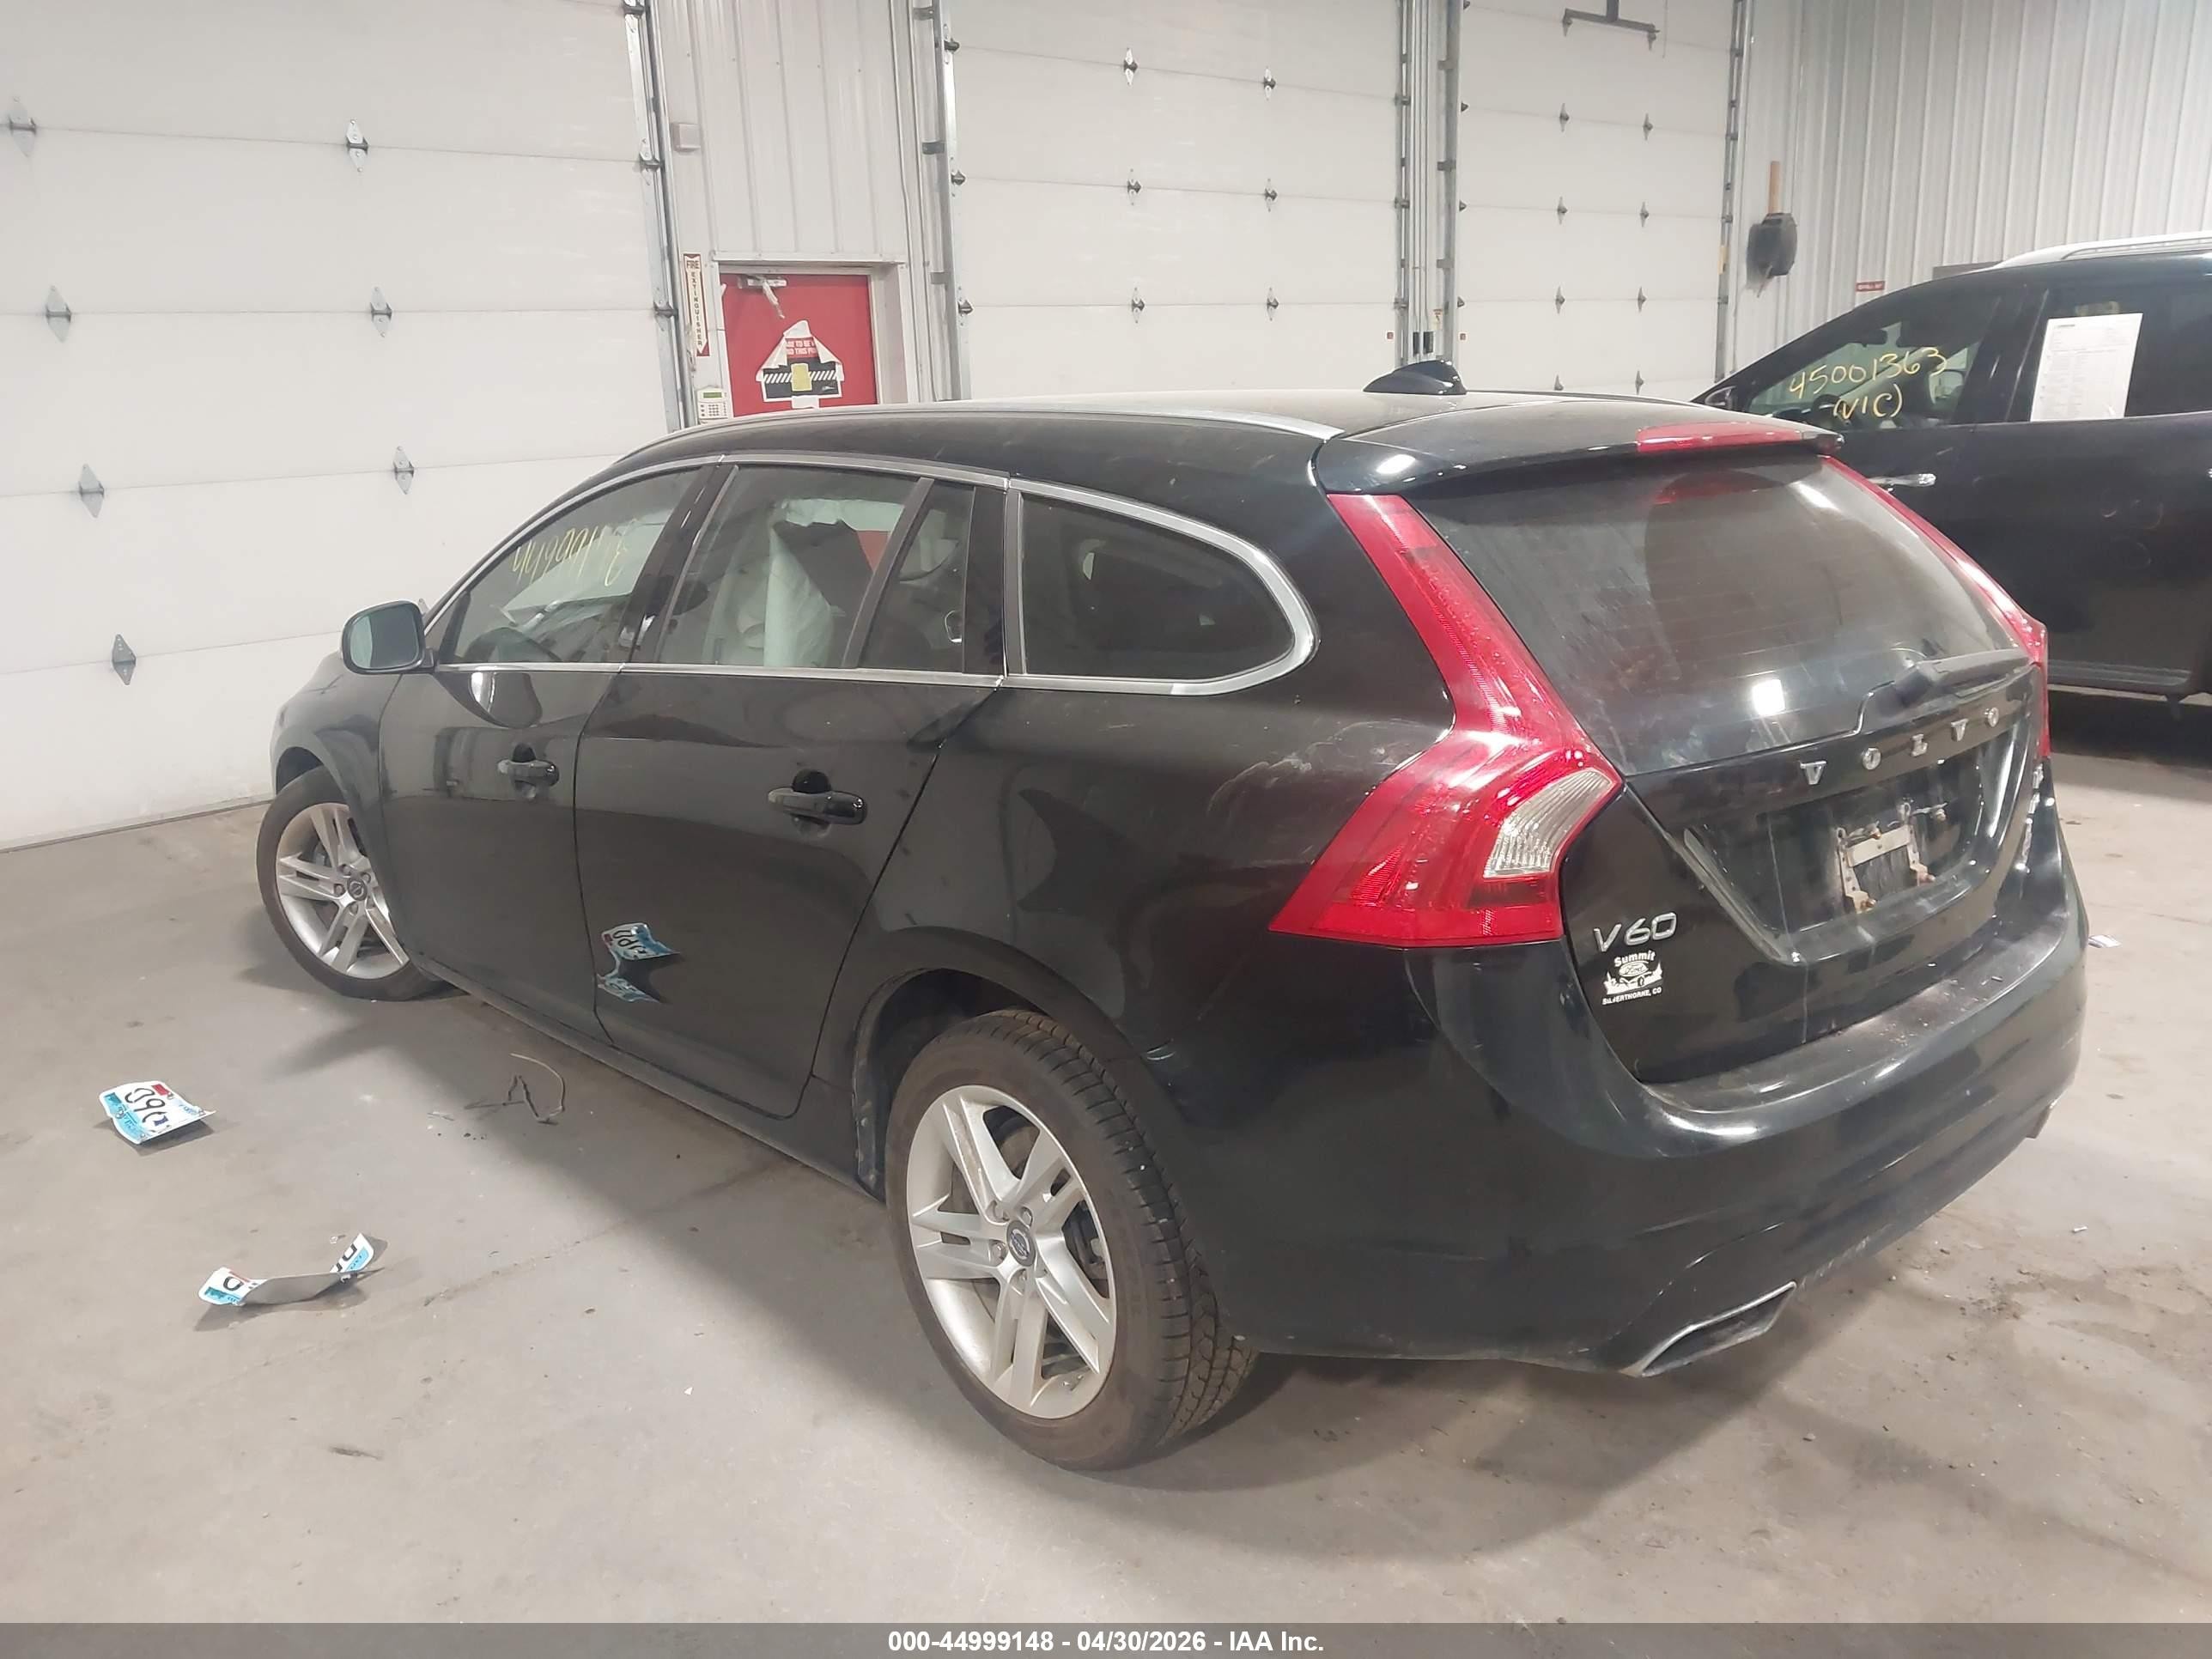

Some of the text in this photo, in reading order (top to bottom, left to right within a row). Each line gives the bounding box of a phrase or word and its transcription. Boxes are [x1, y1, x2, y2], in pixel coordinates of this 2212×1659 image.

[686, 259, 700, 269] FIRE
[1790, 346, 1948, 399] 45001363
[1800, 707, 2000, 786] VOLVO
[1594, 912, 1677, 952] V60
[1614, 950, 1656, 967] Summit
[1652, 987, 1662, 995] CO
